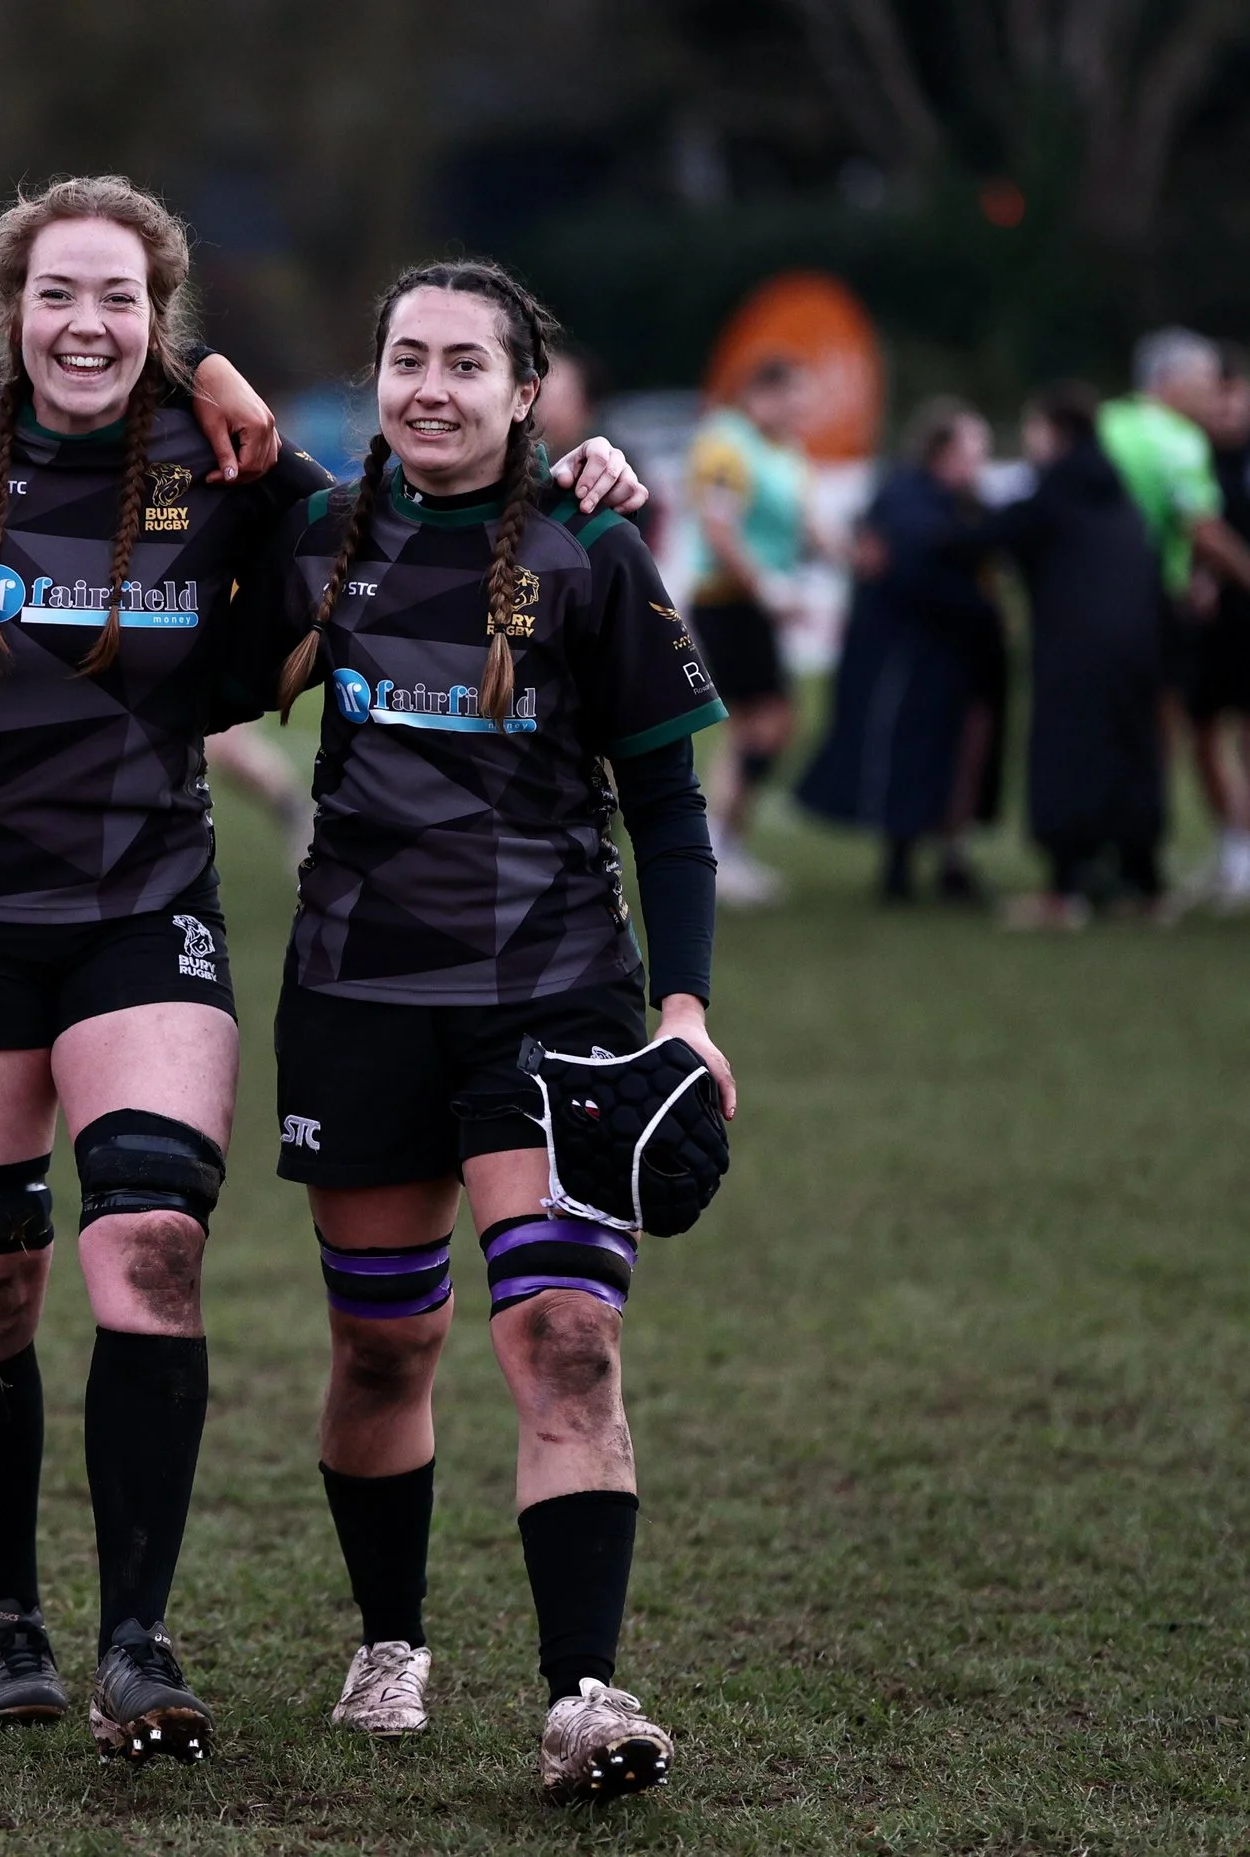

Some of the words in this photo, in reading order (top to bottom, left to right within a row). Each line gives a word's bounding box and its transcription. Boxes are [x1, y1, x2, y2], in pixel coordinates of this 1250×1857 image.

[144, 506, 189, 520] BURY
[144, 519, 190, 531] RUGBY
[348, 581, 378, 596] STC
[152, 615, 192, 625] money
[487, 611, 537, 628] RY
[486, 623, 535, 638] RGBY
[374, 679, 537, 718] fairfid
[488, 721, 528, 730] mney
[178, 954, 216, 973] BURY
[179, 965, 218, 982] RUGBY
[280, 1114, 321, 1151] STC
